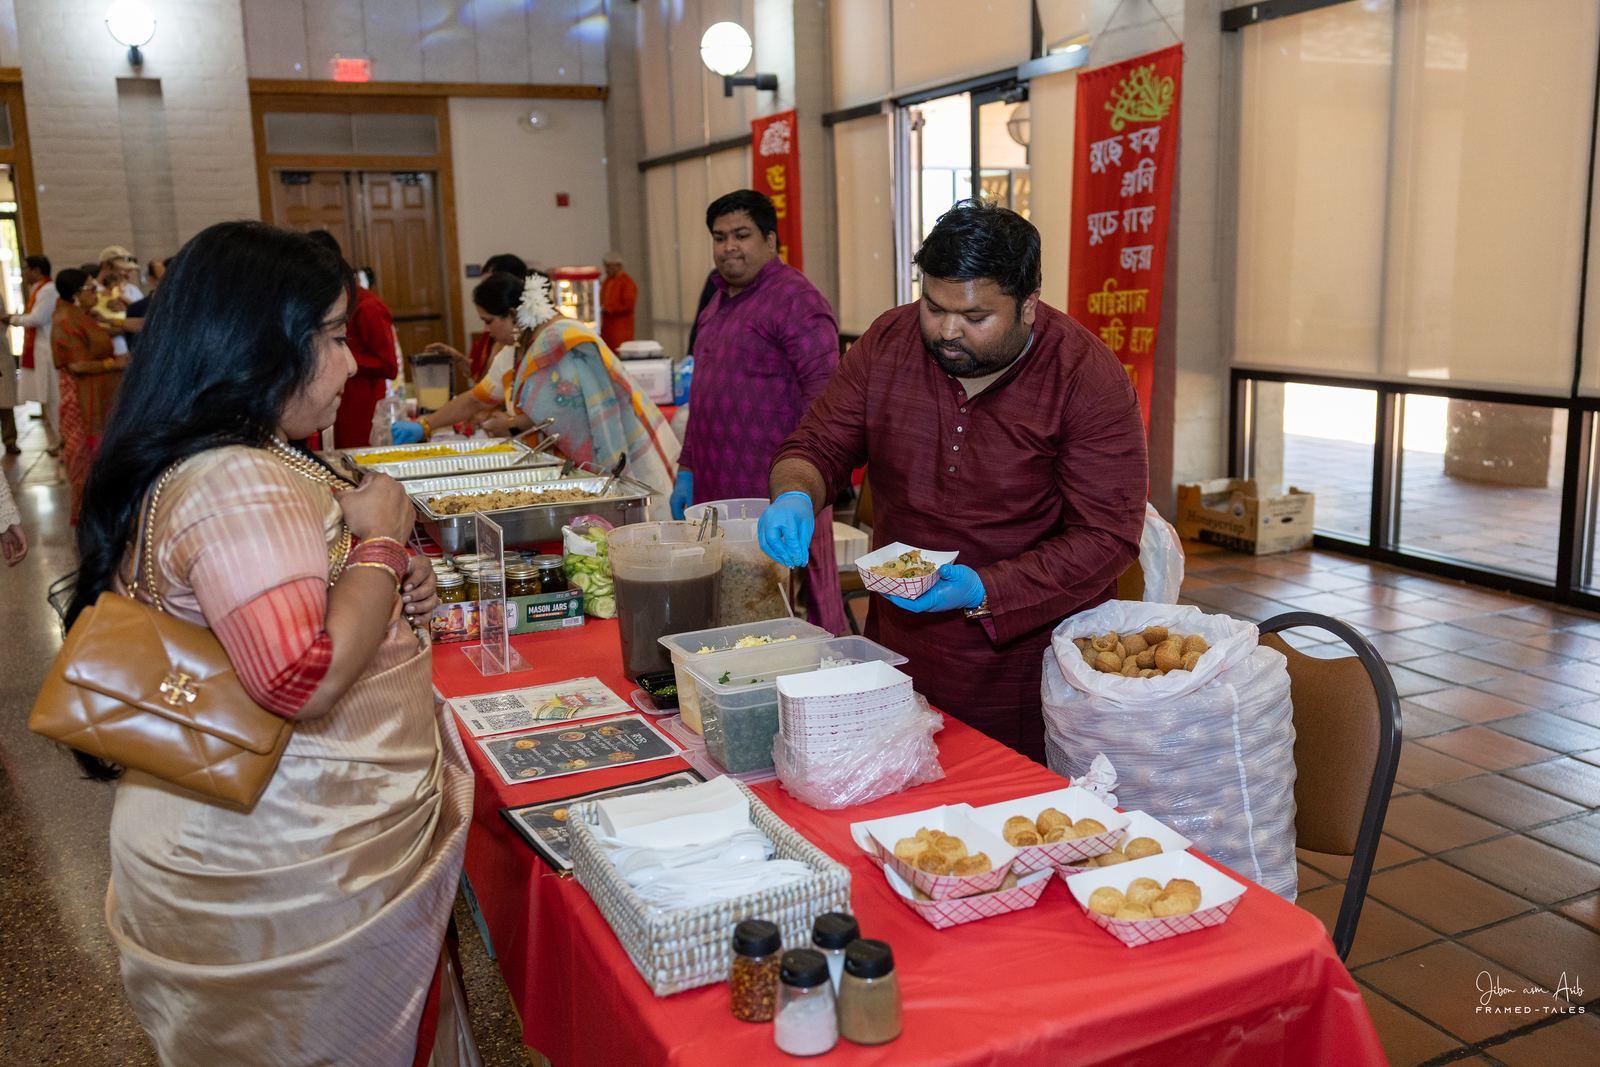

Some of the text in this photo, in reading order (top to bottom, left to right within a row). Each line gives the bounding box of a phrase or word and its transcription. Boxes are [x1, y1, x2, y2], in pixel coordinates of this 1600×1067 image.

[1090, 135, 1124, 173] মুছে
[1087, 210, 1120, 246] ঘুচে
[528, 602, 568, 614] MASON JARS
